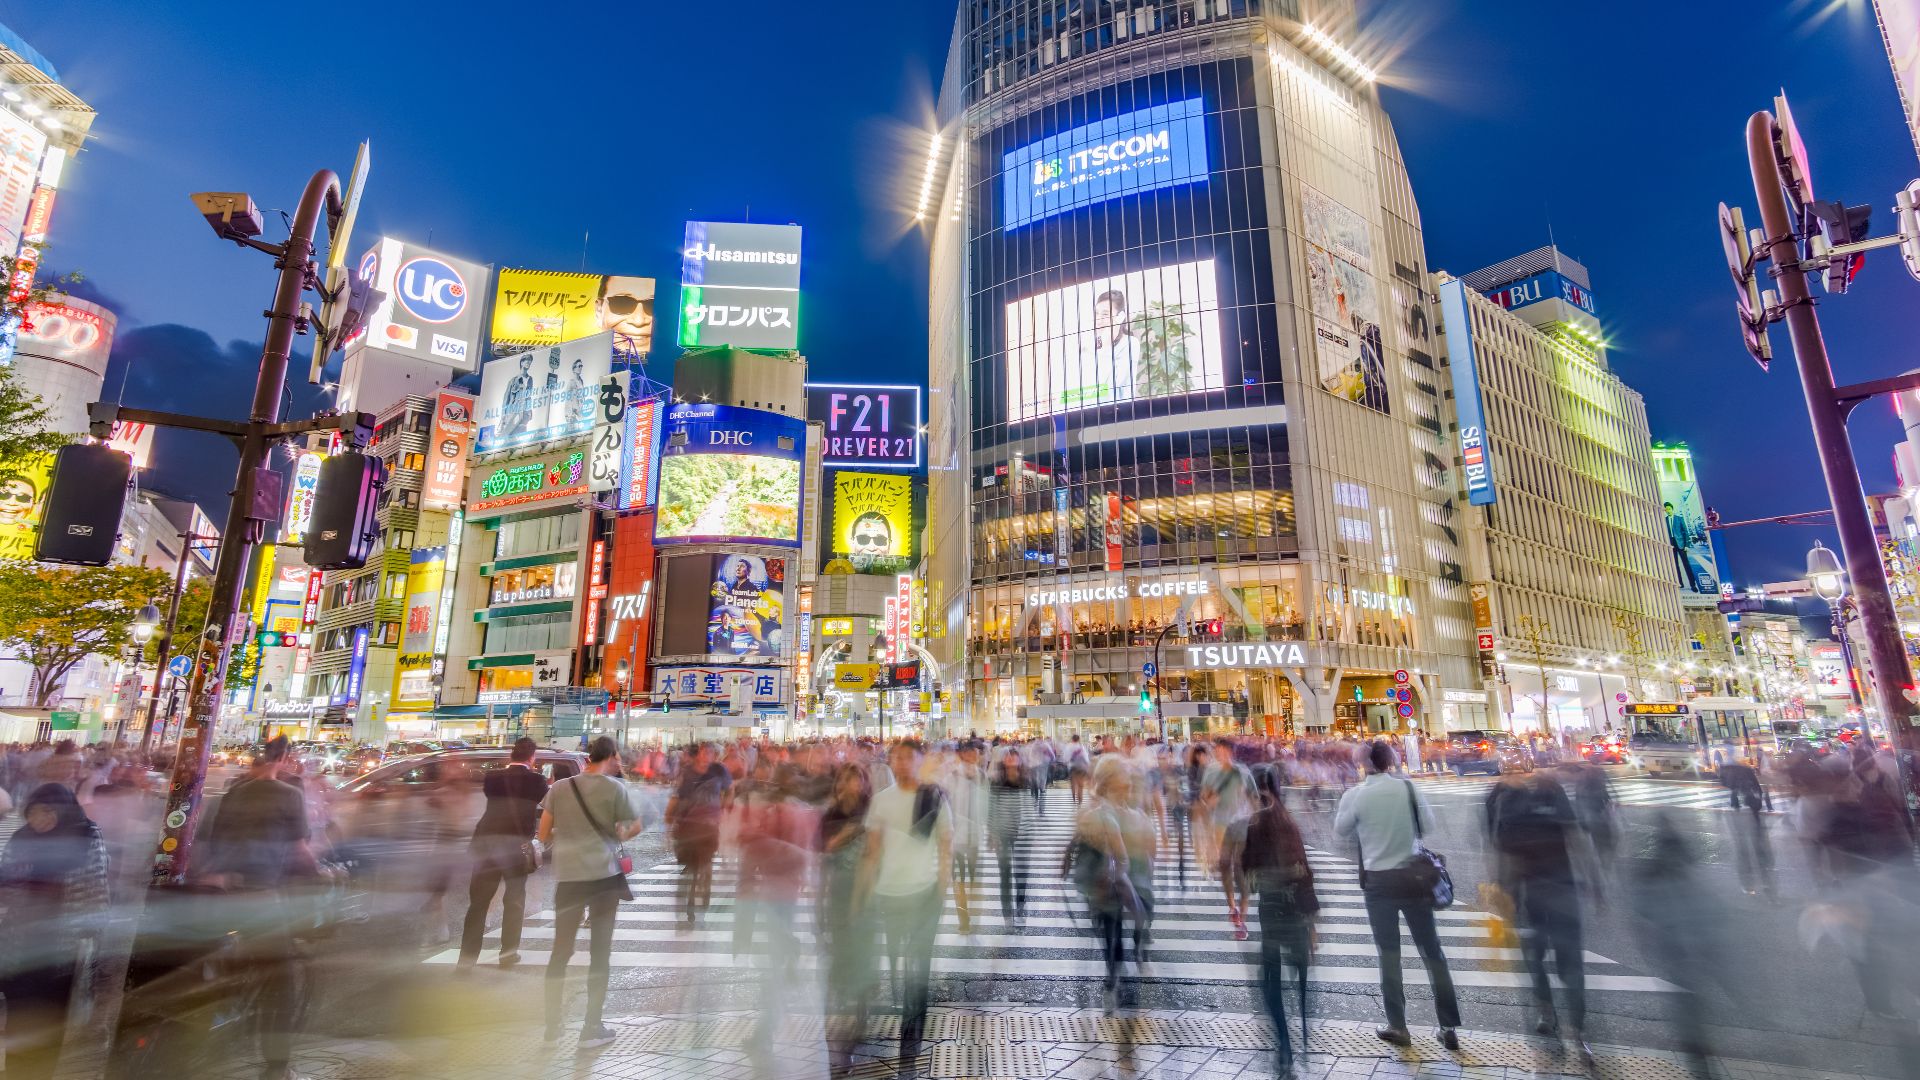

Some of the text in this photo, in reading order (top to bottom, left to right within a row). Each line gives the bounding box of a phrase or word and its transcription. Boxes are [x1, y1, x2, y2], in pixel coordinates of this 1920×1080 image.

[685, 244, 798, 265] Hisamitsu
[404, 268, 460, 310] UC
[504, 290, 592, 310] ヤバババーン
[1498, 280, 1542, 310] IBU
[1562, 280, 1595, 314] SEIBU
[686, 305, 792, 328] サロンパス
[436, 340, 465, 356] VISA
[525, 396, 549, 411] BEST
[669, 409, 715, 420] DHC Channel
[831, 394, 890, 432] F21
[591, 376, 625, 486] もんじゃ
[709, 430, 753, 446] DHC
[823, 437, 913, 457] OREVER 21
[1460, 426, 1489, 493] SEIBU
[508, 470, 543, 493] 西村
[494, 586, 551, 604] Euphoria
[725, 594, 769, 608] Planets
[1030, 580, 1208, 607] STARBUCKS COFFEE
[1721, 583, 1735, 602] SEI
[608, 580, 650, 644] クスリ
[900, 582, 910, 627] カラオケ
[1480, 636, 1492, 648] 本
[1188, 644, 1305, 666] TSUTAYA
[661, 673, 775, 696] 大盛堂店
